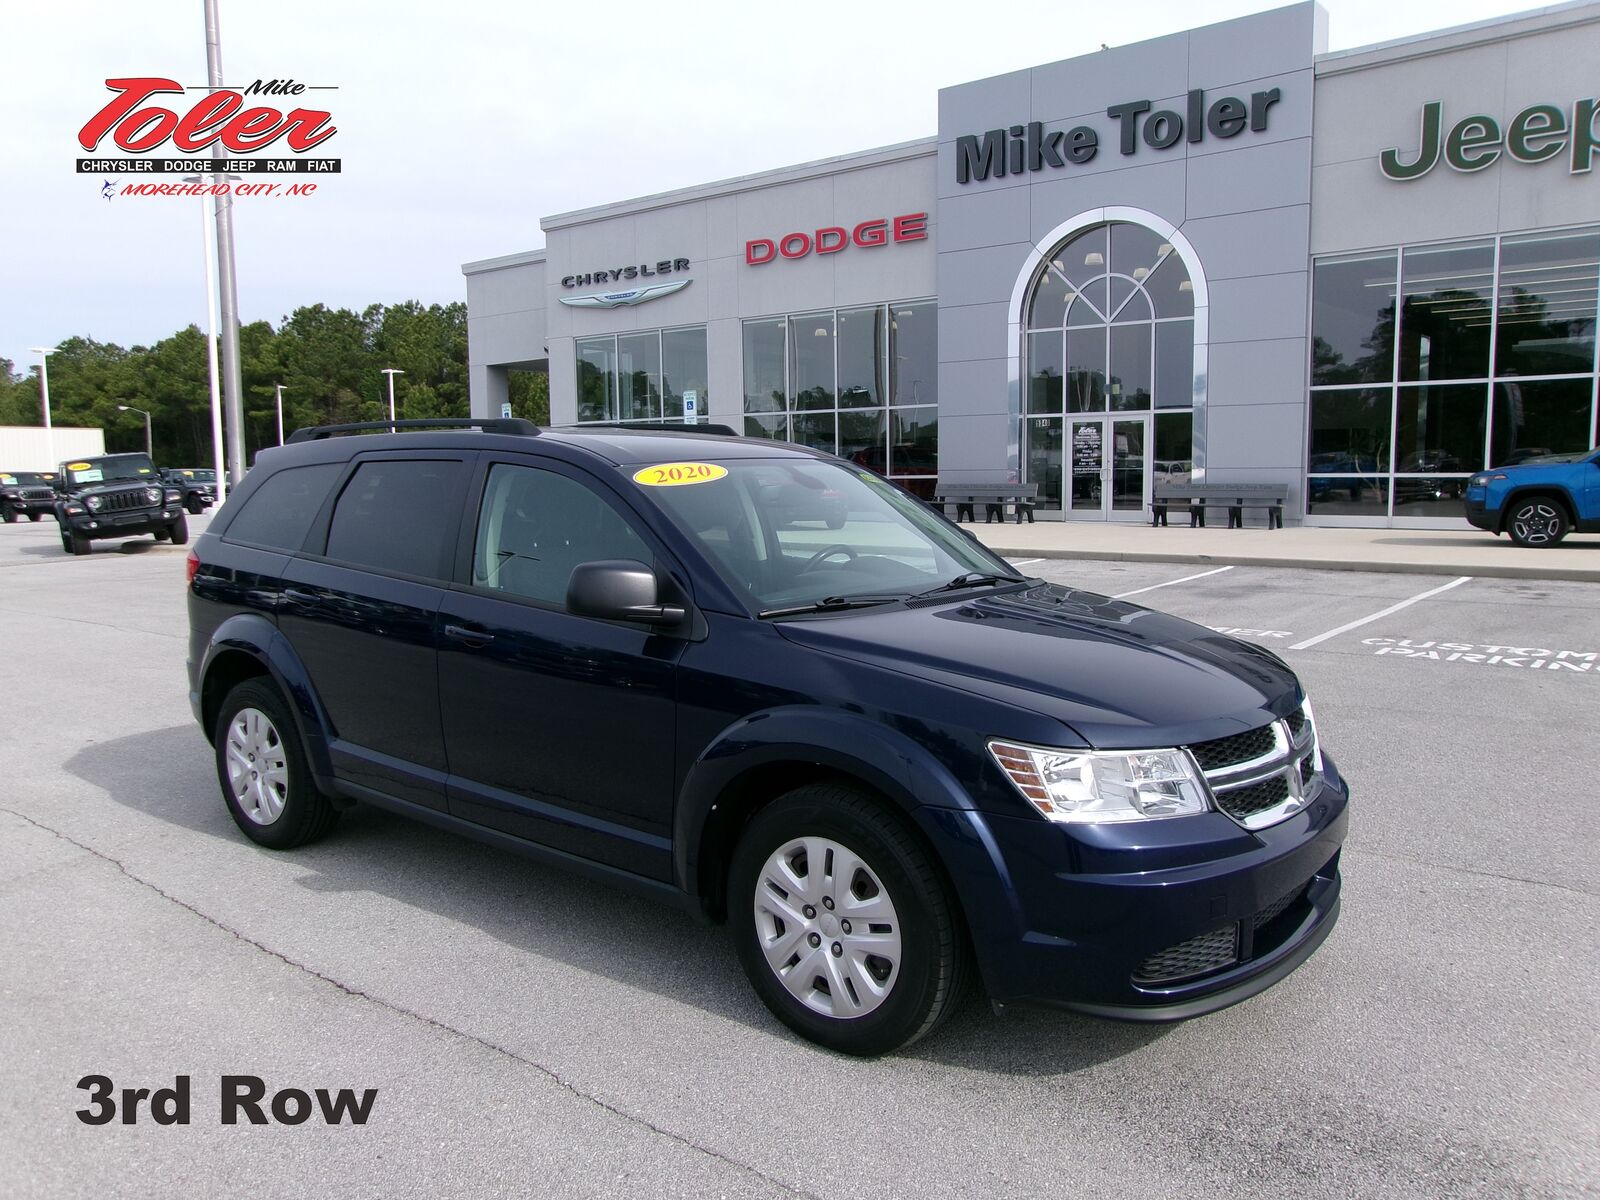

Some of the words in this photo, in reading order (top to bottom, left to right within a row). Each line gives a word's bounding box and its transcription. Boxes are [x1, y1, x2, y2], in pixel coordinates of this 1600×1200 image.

[956, 121, 1099, 184] Mike
[1107, 87, 1281, 155] Toler
[745, 212, 928, 266] DODGE
[561, 257, 691, 289] CHRYSLER
[653, 465, 711, 483] 2020
[1361, 638, 1599, 661] CUSTOM
[1374, 647, 1600, 672] PARKIN
